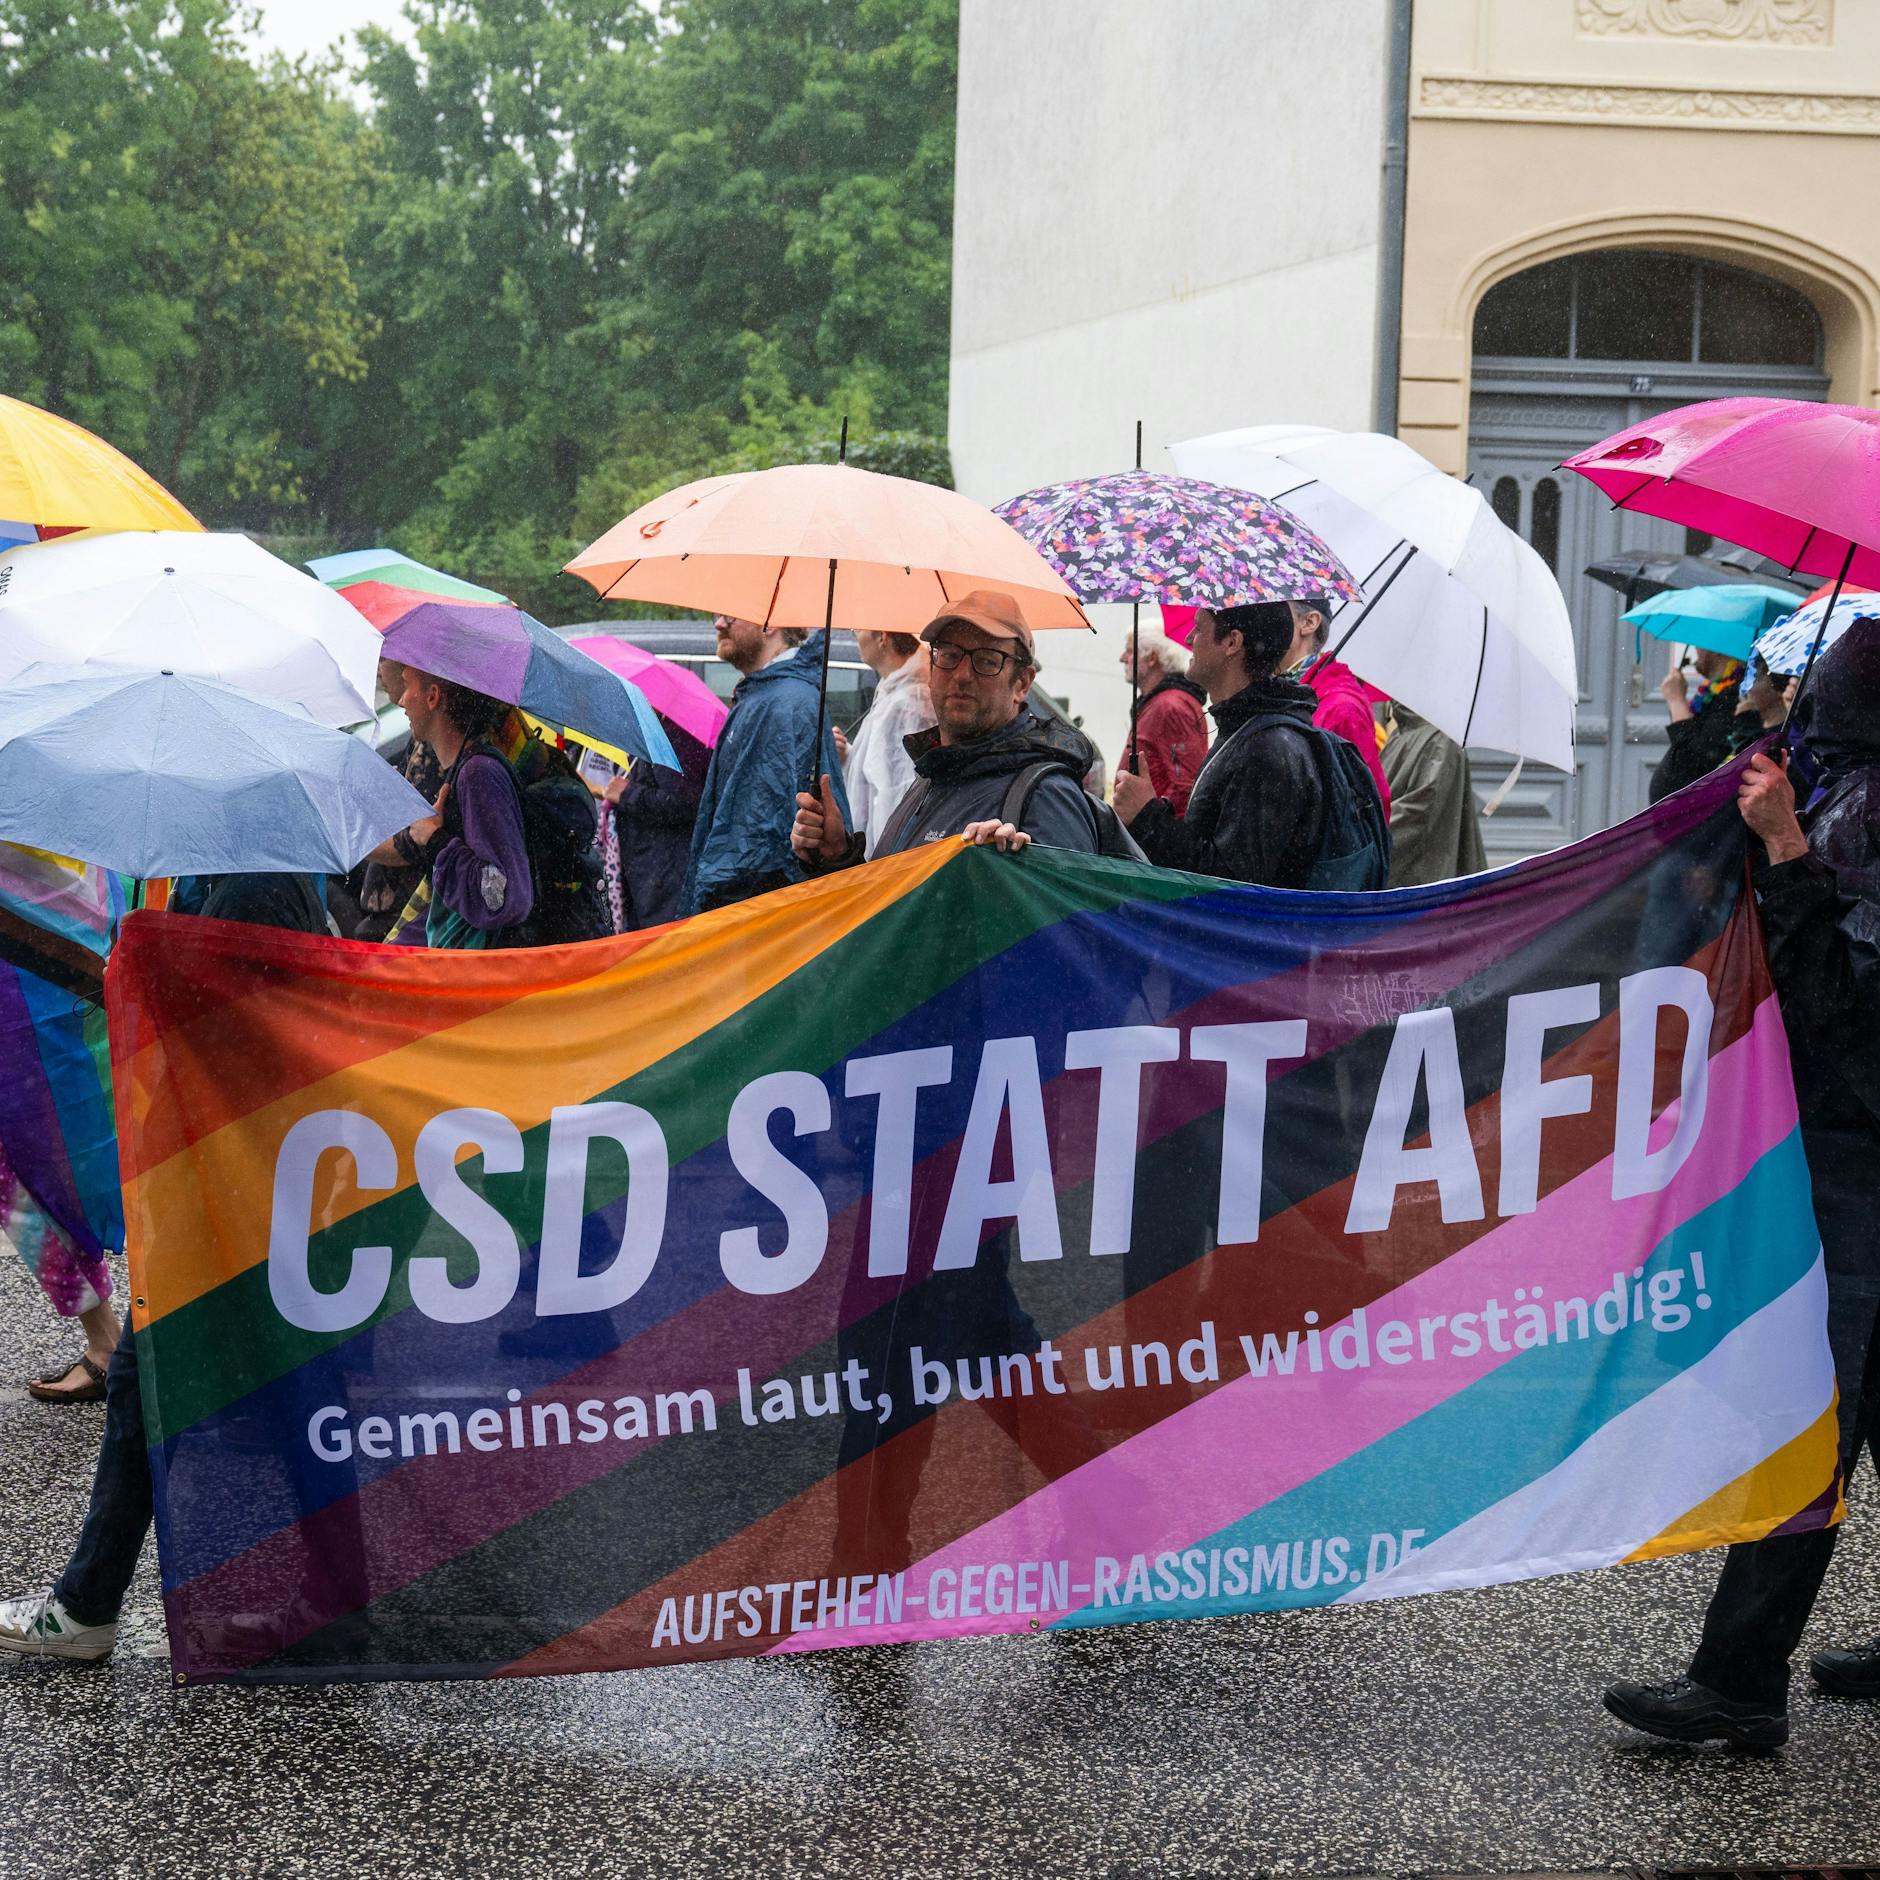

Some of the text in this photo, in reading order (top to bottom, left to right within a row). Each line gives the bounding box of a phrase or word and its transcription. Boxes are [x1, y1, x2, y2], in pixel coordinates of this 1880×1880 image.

[267, 966, 1714, 1332] CSD STATT AFD
[307, 1251, 1713, 1463] Gemeinsam laut, bunt und widerständig!
